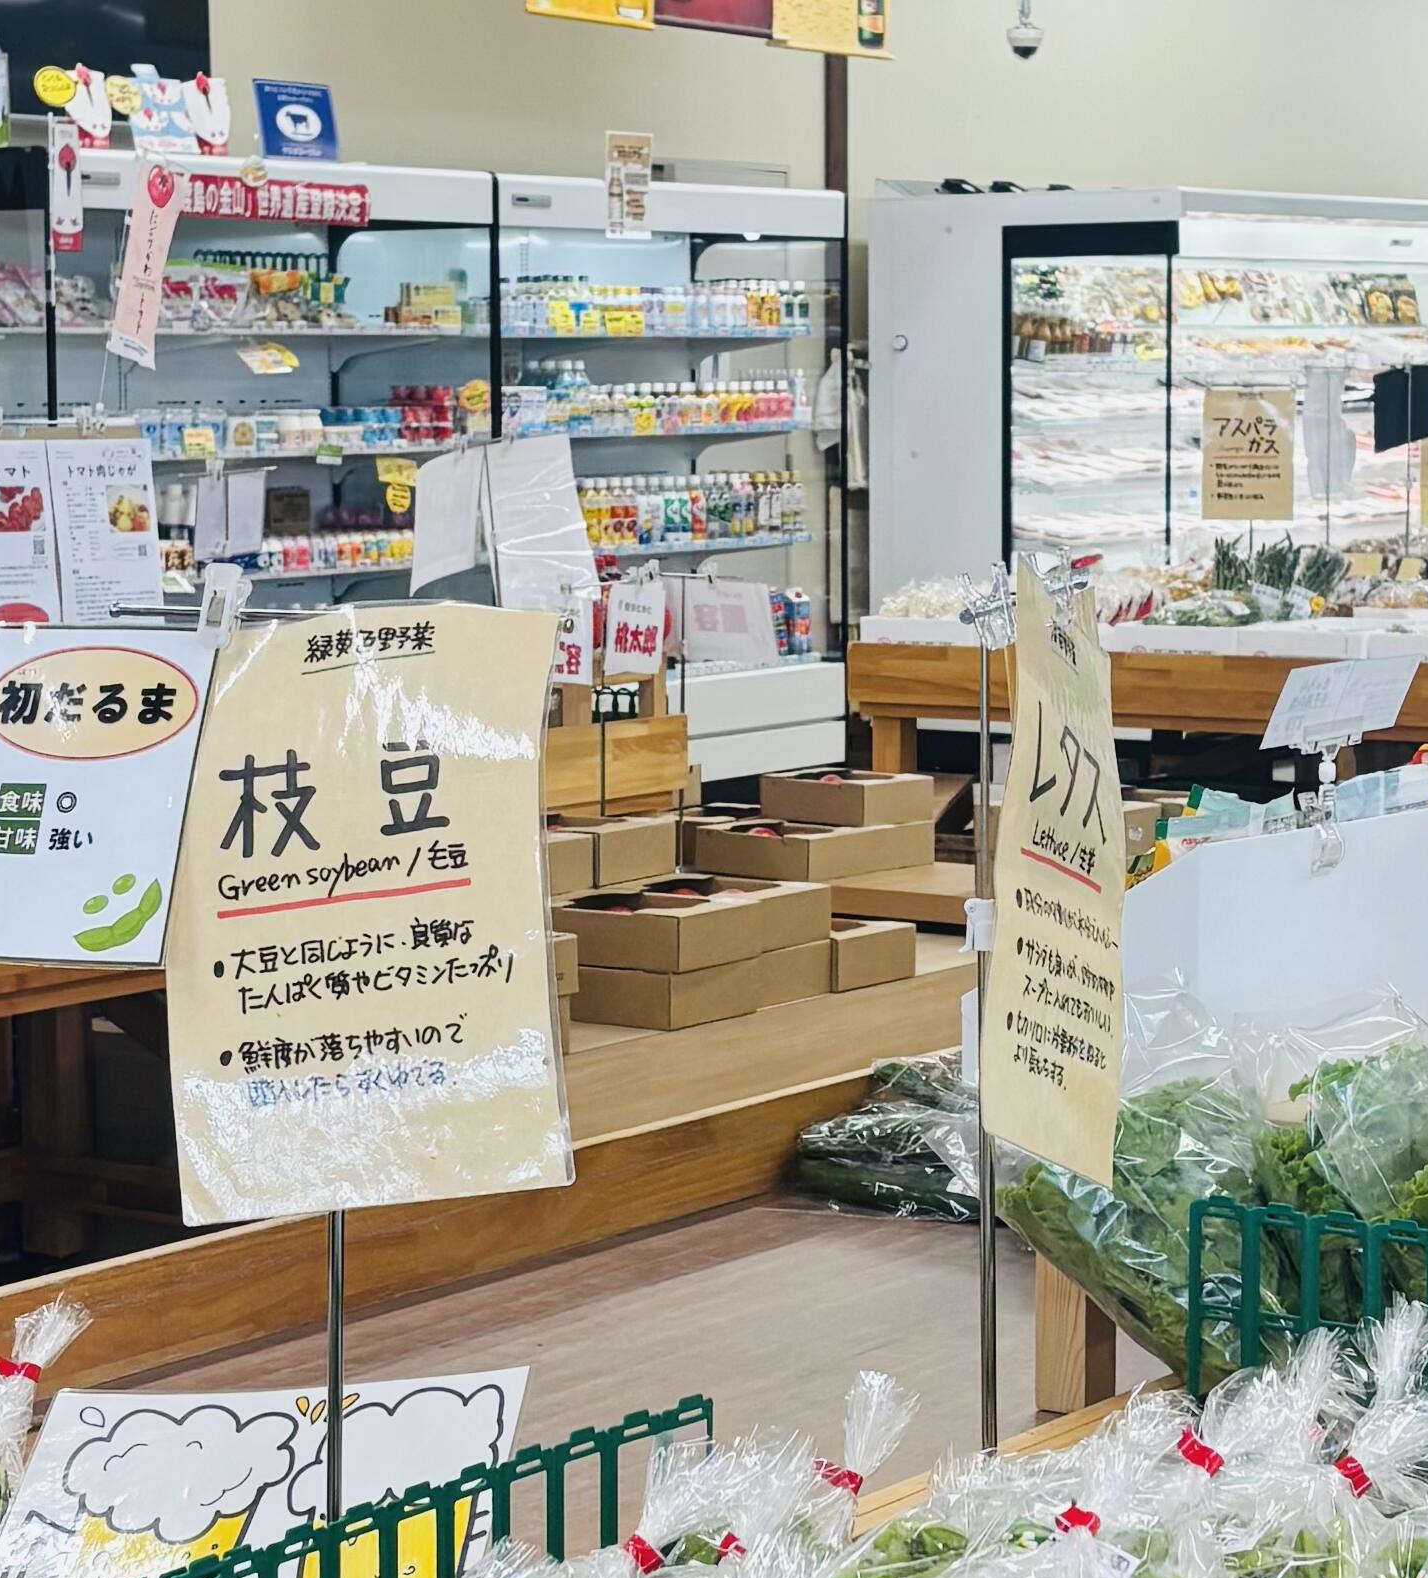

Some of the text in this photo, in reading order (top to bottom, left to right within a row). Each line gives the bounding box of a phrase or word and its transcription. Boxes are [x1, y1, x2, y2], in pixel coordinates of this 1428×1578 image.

[1213, 416, 1277, 437] アスパラ
[1248, 436, 1279, 454] ガス
[304, 622, 436, 665] 緑黄色野菜
[615, 621, 659, 657] 桃太郎
[1031, 700, 1107, 845] レタス
[0, 789, 44, 814] 食味
[219, 739, 451, 859] 枝豆
[48, 827, 93, 851] 強い
[218, 868, 301, 901] Green
[306, 854, 401, 900] soybean
[427, 841, 470, 872] 毛豆
[239, 944, 516, 1014] たんぱく質やビタミンたっぷり
[239, 1014, 469, 1073] 鮮度が落ちやすいので
